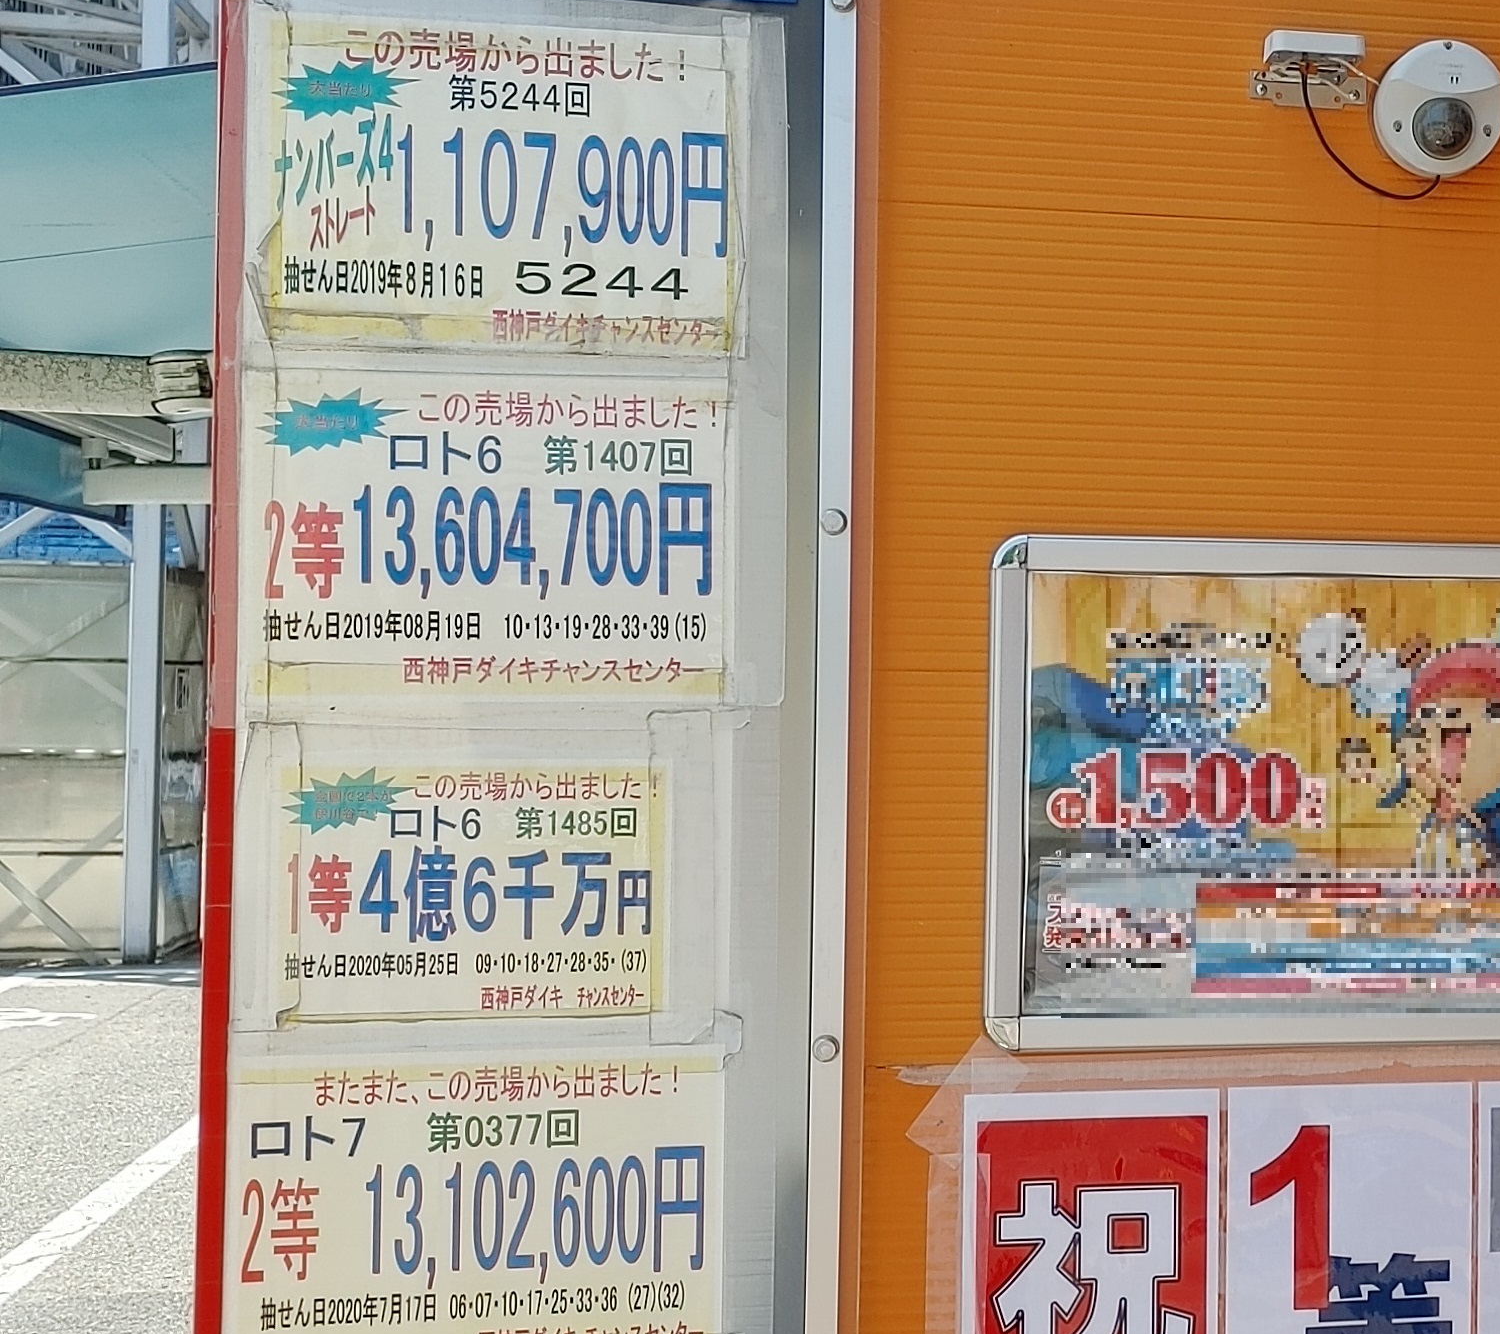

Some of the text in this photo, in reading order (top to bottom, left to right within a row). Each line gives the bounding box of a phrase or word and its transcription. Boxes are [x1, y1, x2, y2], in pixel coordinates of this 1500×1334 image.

[343, 28, 688, 84] この売場から出ました！
[309, 81, 373, 98] 大当たり
[448, 75, 591, 118] 第5244回
[274, 113, 394, 213] ナンバーズ4
[398, 124, 728, 259] 1,107,900円
[309, 186, 376, 252] ストレート
[284, 256, 689, 301] 抽せん日2019年8月16日 5244
[418, 390, 719, 430] この売場から出ました！
[388, 431, 693, 476] ロト6 第1407回
[264, 483, 712, 600] 2等 13,604,700円
[263, 609, 481, 642] 抽せん日2019年08月19日
[403, 656, 704, 685] 西神戸ダイキチャンスセンター
[413, 772, 659, 801] この売場から出ました！
[389, 805, 637, 841] ロト6 第1485回
[287, 845, 651, 944] 1等 4億6千万円
[284, 953, 459, 979] 抽せん日2020年05月25日
[480, 987, 563, 1009] 西神戸ダイキ
[250, 1109, 580, 1161] ロト7 第0377回
[241, 1144, 705, 1290] 2等 13,102,600円
[260, 1292, 437, 1331] 抽せん日2020年7月17日
